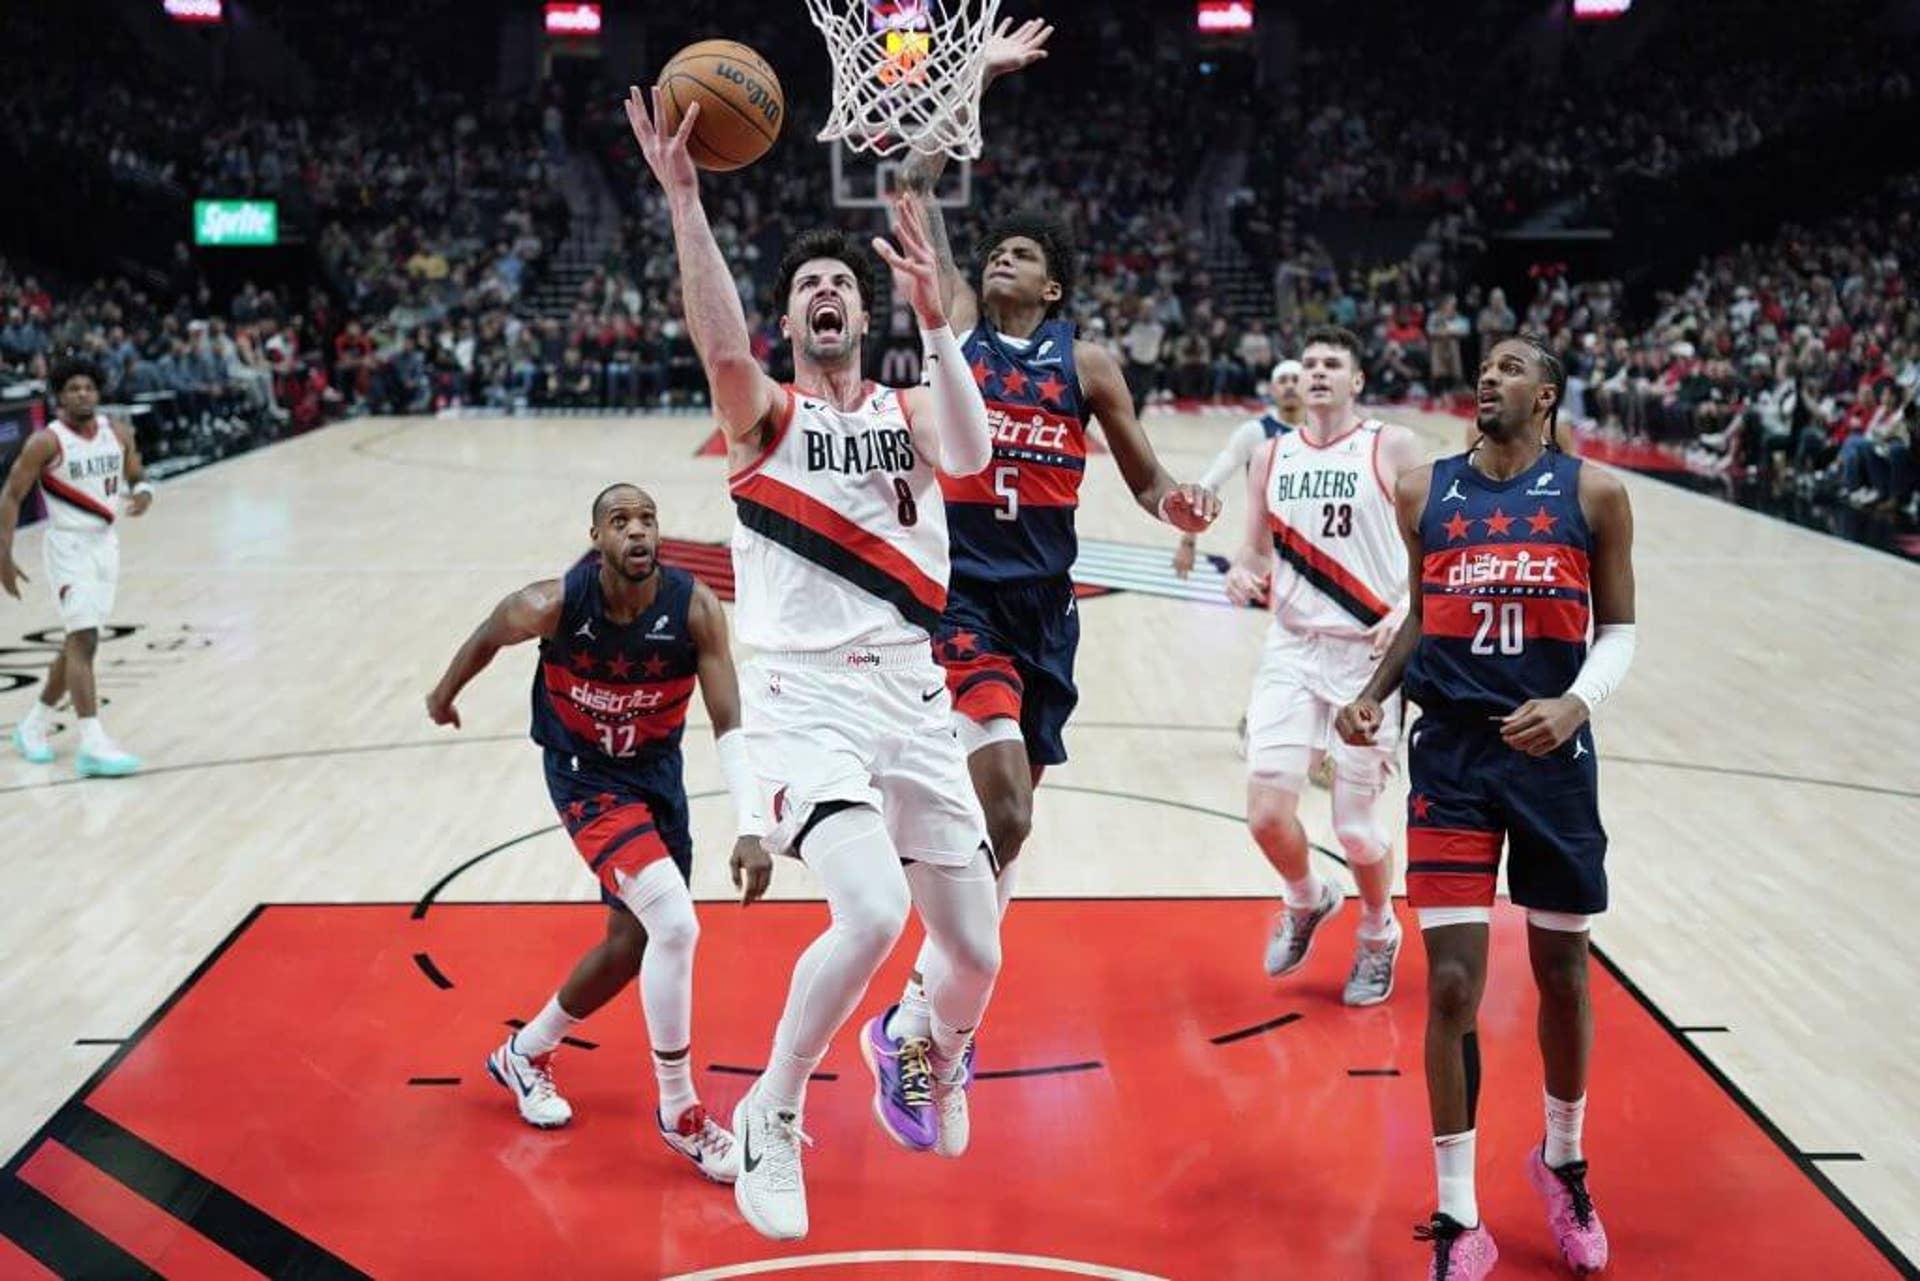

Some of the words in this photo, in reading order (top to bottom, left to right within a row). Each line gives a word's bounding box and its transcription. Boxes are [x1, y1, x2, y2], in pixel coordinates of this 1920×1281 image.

[716, 62, 780, 121] Wilson
[202, 202, 271, 244] Sprite
[987, 413, 1068, 449] strict
[893, 477, 918, 527] 8
[994, 466, 1020, 522] 5
[1278, 469, 1358, 502] BLAZERS
[1321, 503, 1353, 538] 23
[1448, 550, 1559, 586] district
[1470, 601, 1524, 656] 20
[570, 681, 663, 713] district
